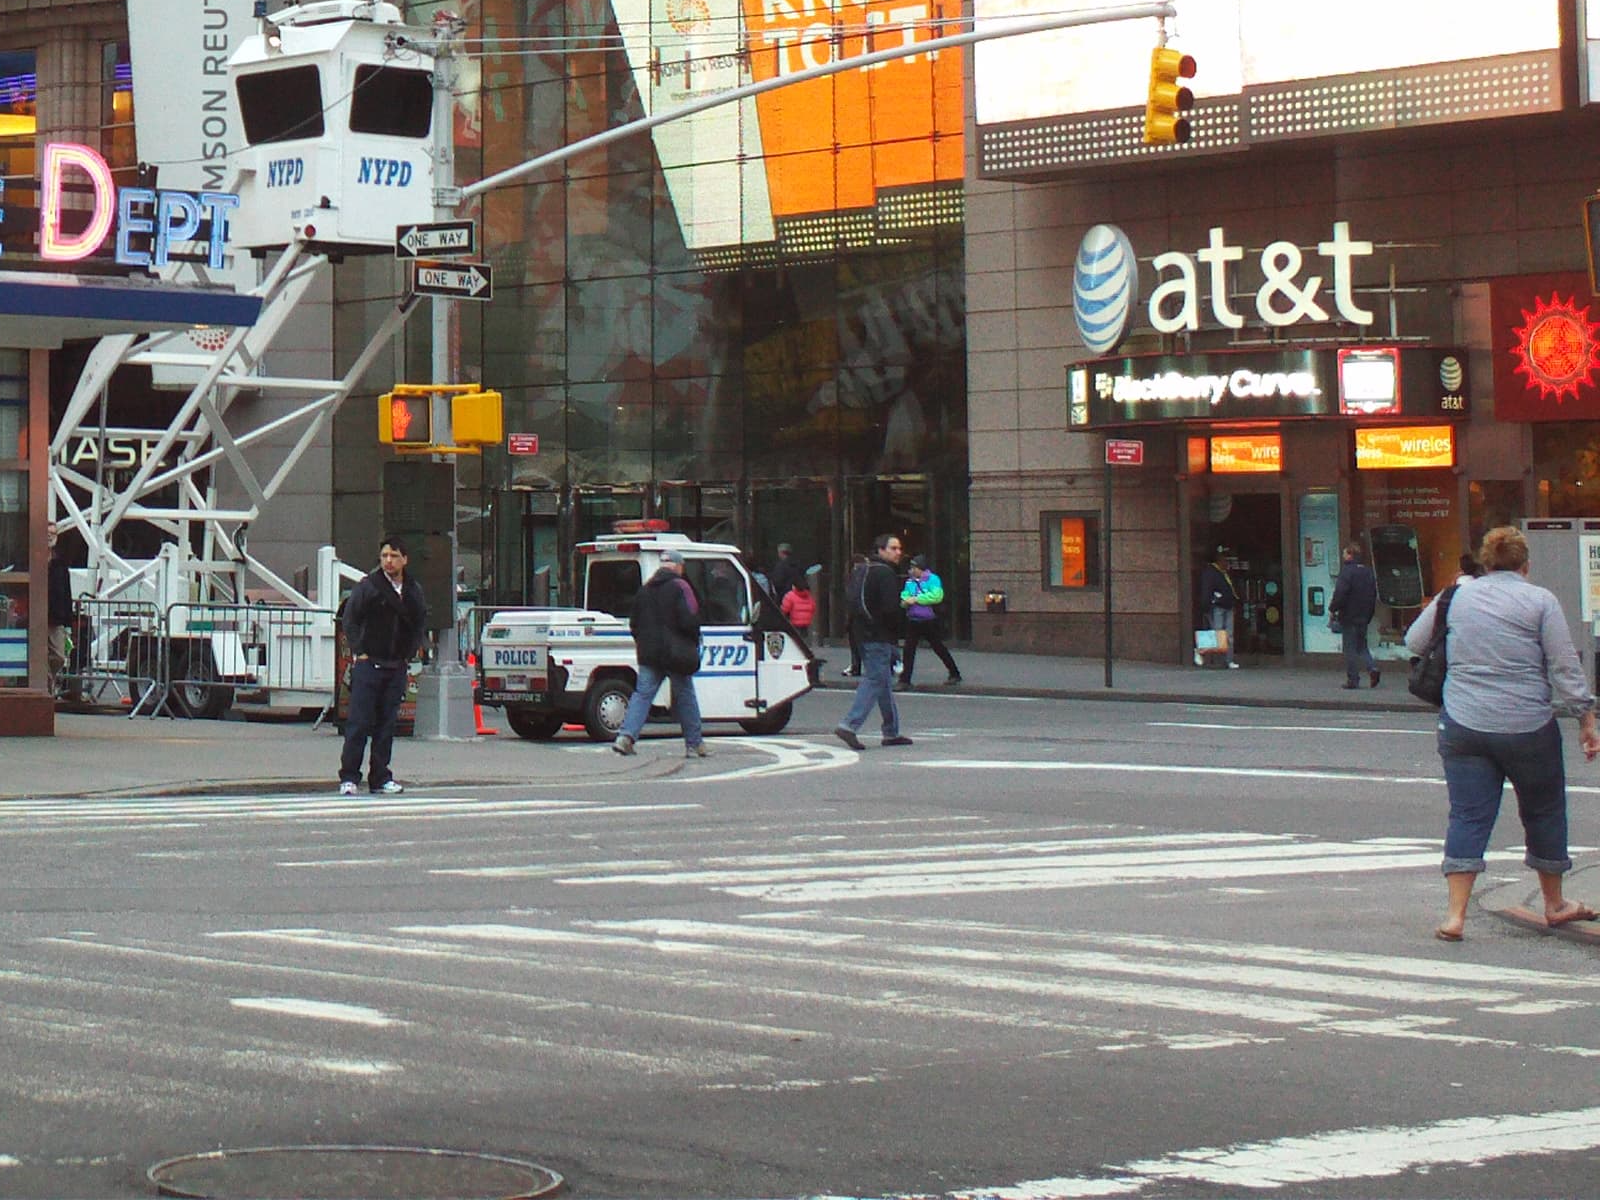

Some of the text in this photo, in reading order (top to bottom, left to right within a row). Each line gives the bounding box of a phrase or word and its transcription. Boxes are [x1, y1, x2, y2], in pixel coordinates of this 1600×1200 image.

[266, 157, 304, 188] NYPD
[357, 157, 413, 188] NYPD
[40, 142, 240, 270] DEPT
[407, 231, 463, 248] ONE WAY
[425, 271, 480, 288] ONE WAY
[1147, 220, 1375, 334] at&t
[1440, 395, 1464, 410] at&t
[495, 649, 537, 666] POLICE
